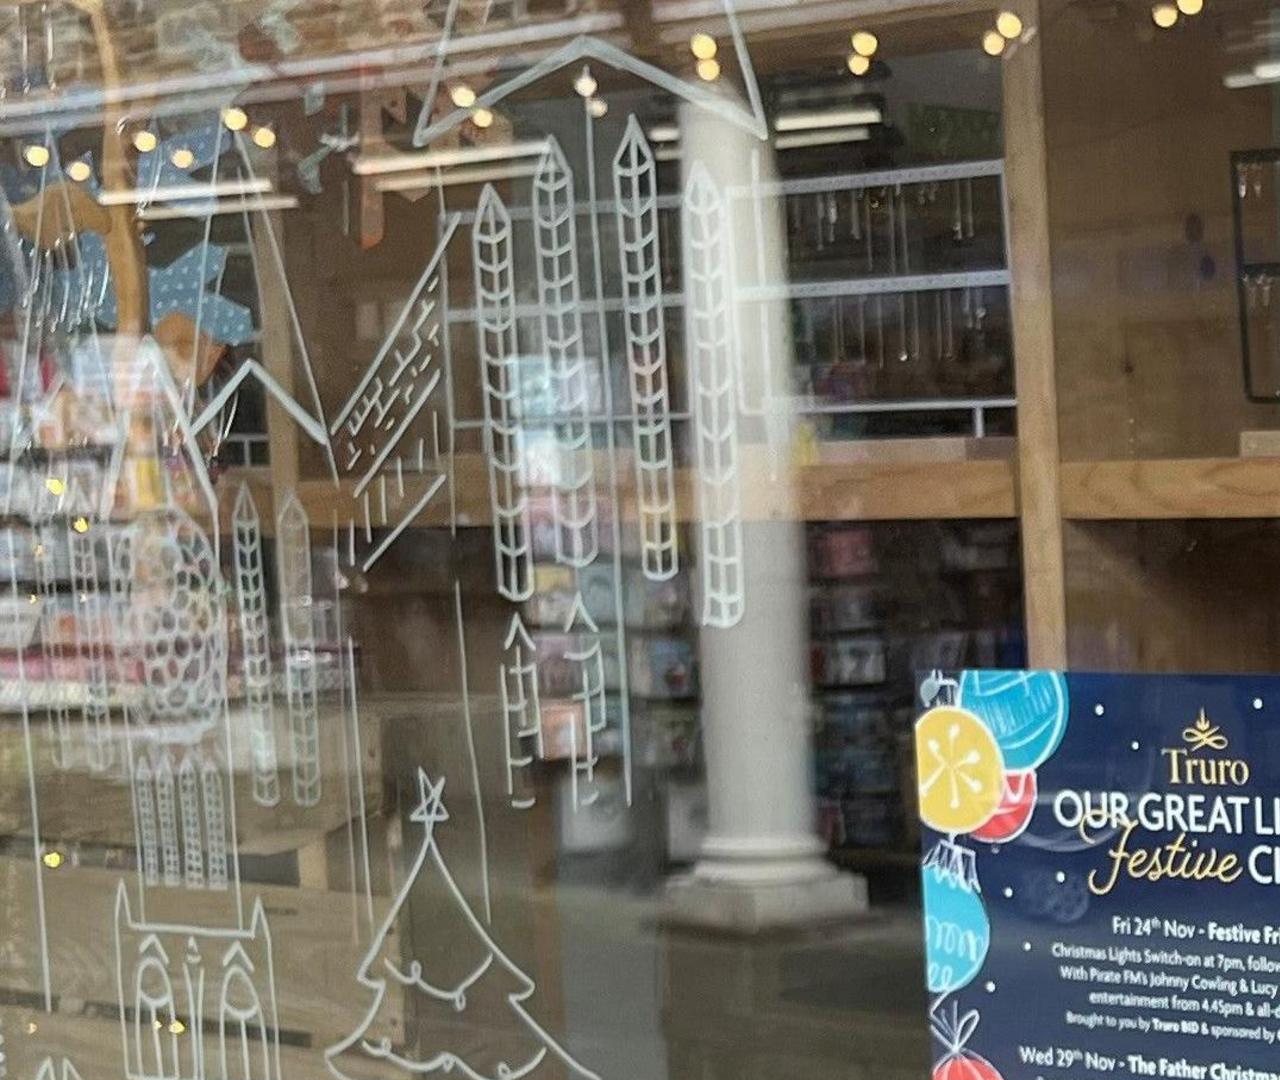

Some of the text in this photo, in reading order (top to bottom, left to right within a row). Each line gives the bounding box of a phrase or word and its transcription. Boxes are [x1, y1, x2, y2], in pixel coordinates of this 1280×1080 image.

[1161, 748, 1249, 785] Truro
[1054, 790, 1130, 829] OUR
[1137, 793, 1250, 834] GREAT
[1080, 808, 1243, 895] Festive
[1111, 915, 1131, 935] Fri
[1133, 915, 1161, 936] 24th
[1163, 918, 1196, 939] Nov
[1207, 920, 1261, 944] Festive
[1050, 941, 1108, 961] Christmas
[1107, 945, 1143, 966] Lights
[1143, 947, 1202, 967] Switch-on
[1202, 954, 1215, 969] at
[1059, 965, 1089, 981] With
[1088, 966, 1122, 985] Pirate
[1148, 971, 1190, 993] Johnny
[1238, 977, 1249, 994] &
[1249, 978, 1279, 1000] Lucy
[1088, 991, 1170, 1010] entertainment
[1170, 994, 1201, 1012] from
[1244, 1000, 1255, 1017] &
[1018, 1045, 1054, 1066] Wed
[1055, 1047, 1083, 1068] 29th
[1084, 1051, 1116, 1071] Nov
[1126, 1053, 1157, 1076] The
[1157, 1057, 1208, 1080] Father
